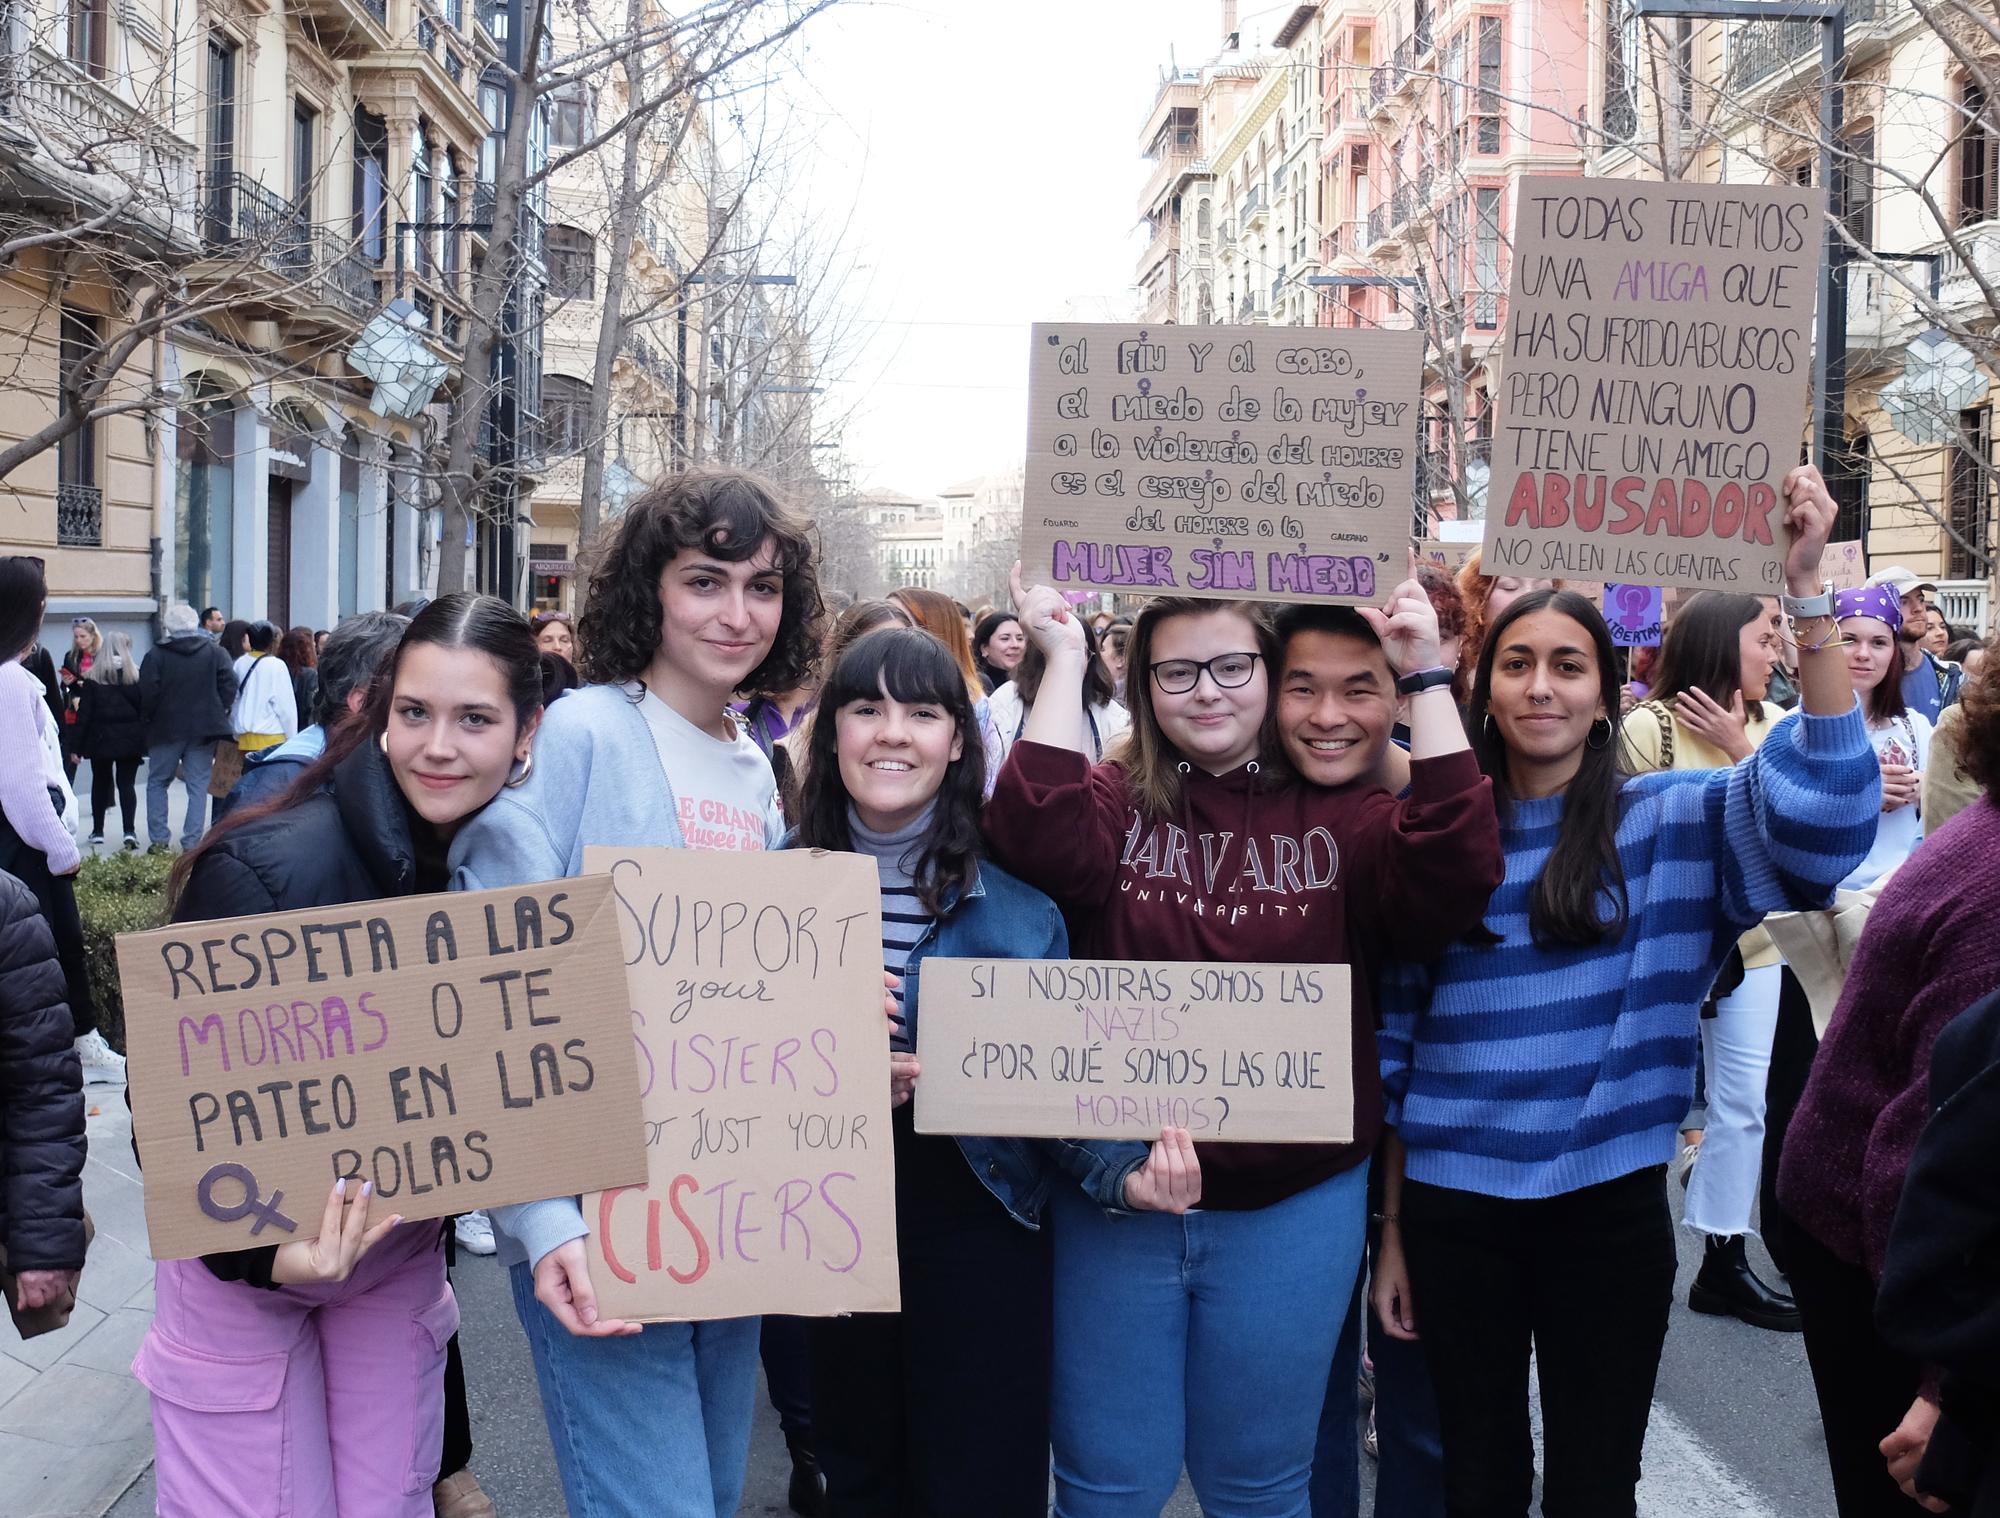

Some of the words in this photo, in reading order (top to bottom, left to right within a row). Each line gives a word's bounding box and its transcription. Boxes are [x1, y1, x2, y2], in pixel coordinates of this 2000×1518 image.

[1532, 196, 1648, 242] TODAS
[1667, 199, 1808, 252] TENEMOS
[1522, 255, 1592, 300] UNA
[1613, 261, 1709, 301] AMIGA
[1723, 264, 1798, 308] QUE
[1188, 343, 1213, 373] Y
[1228, 340, 1256, 373] al
[1513, 311, 1558, 359] HA
[1564, 313, 1679, 368] SUFRIDO
[1680, 321, 1800, 374] ABUSOS
[1057, 387, 1090, 420] el
[1218, 385, 1261, 422] de
[1273, 387, 1303, 422] la
[1508, 372, 1580, 420] PERO
[1589, 378, 1756, 434] NINGUNO
[1053, 434, 1078, 457] a
[1091, 428, 1120, 459] la
[1267, 433, 1314, 465] del
[1506, 427, 1608, 472] TIENE
[1622, 434, 1661, 475] UN
[1671, 440, 1770, 481] AMIGO
[1051, 472, 1087, 496] es
[1095, 469, 1126, 497] el
[1241, 469, 1287, 504] del
[1504, 471, 1777, 546] ABUSADOR
[1043, 517, 1079, 528] EDUARDO
[1126, 505, 1166, 532] del
[1257, 519, 1274, 537] a
[1281, 515, 1304, 539] la
[1330, 532, 1369, 543] GALEANO
[1052, 540, 1180, 588] MUJER
[1187, 540, 1257, 591] SIN
[1493, 537, 1532, 567] NO
[1540, 540, 1604, 572] SALEN
[1614, 548, 1647, 577] LAS
[1654, 551, 1741, 582] CUENTAS
[1761, 559, 1783, 584] (?)
[610, 858, 869, 980] SUPPORT
[161, 917, 398, 999] RESPETA
[426, 910, 458, 965] A
[484, 893, 575, 955] LAS
[670, 978, 775, 1024] your
[971, 965, 996, 999] SI
[1029, 966, 1172, 1002] NOSOTRAS
[1190, 969, 1264, 1003] SOMOS
[1281, 970, 1324, 1004] LAS
[178, 991, 389, 1077] MORRAS
[432, 982, 464, 1039] O
[479, 968, 561, 1031] TE
[1075, 1003, 1190, 1042] "NAZIS"
[962, 1037, 1037, 1081] ¿POR
[1051, 1041, 1104, 1084] QUÉ
[1124, 1047, 1207, 1085] SOMOS
[1222, 1050, 1265, 1089] LAS
[1275, 1051, 1326, 1089] QUE
[189, 1073, 357, 1152] PATEO
[389, 1063, 457, 1124] EN
[496, 1039, 595, 1110] LAS
[1076, 1095, 1230, 1135] MORIMOS?
[644, 1116, 679, 1148] OT
[691, 1108, 761, 1160] JUST
[788, 1112, 869, 1151] YOUR
[332, 1130, 493, 1205] BOLAS
[600, 1171, 862, 1285] CISTERS
